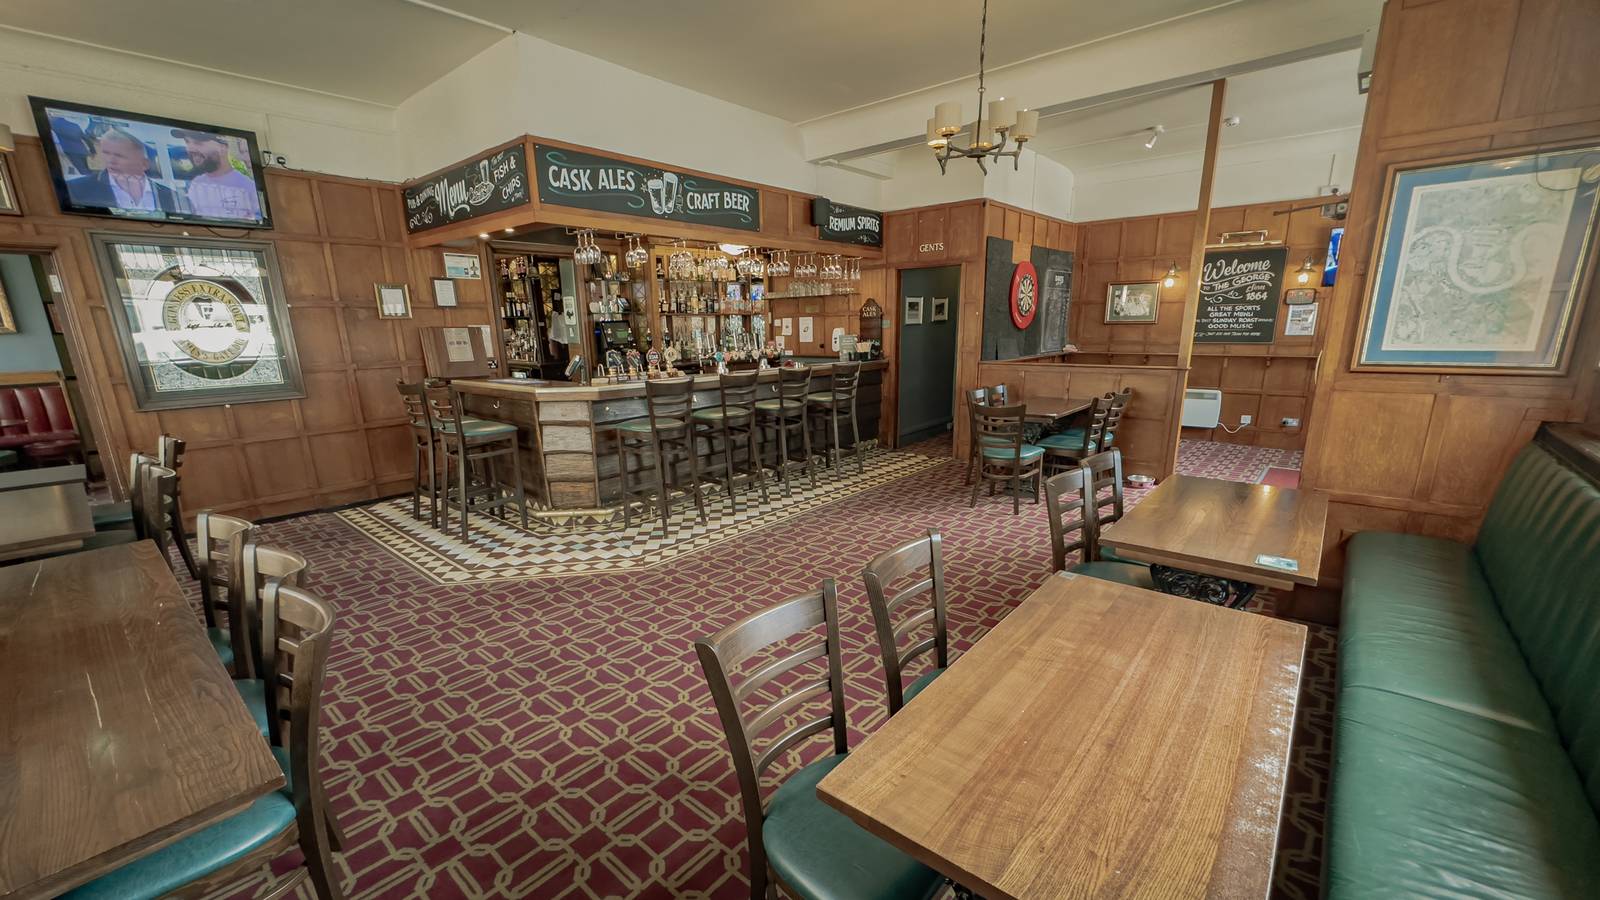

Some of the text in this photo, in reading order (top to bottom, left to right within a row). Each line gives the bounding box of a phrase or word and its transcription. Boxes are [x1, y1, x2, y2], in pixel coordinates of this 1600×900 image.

[493, 164, 509, 183] FISH
[510, 156, 516, 169] &
[549, 165, 636, 191] CASK ALES
[434, 178, 470, 217] Menu
[502, 176, 521, 199] CHIPS
[687, 191, 750, 212] CRAFT BEER
[829, 216, 880, 233] REMIUM SPIRITS
[920, 243, 944, 252] GENTS
[1204, 259, 1271, 281] Welcome
[191, 284, 227, 301] EXTRA
[1213, 281, 1230, 291] THE
[1232, 273, 1271, 286] GEORGE
[1246, 292, 1268, 301] 1864
